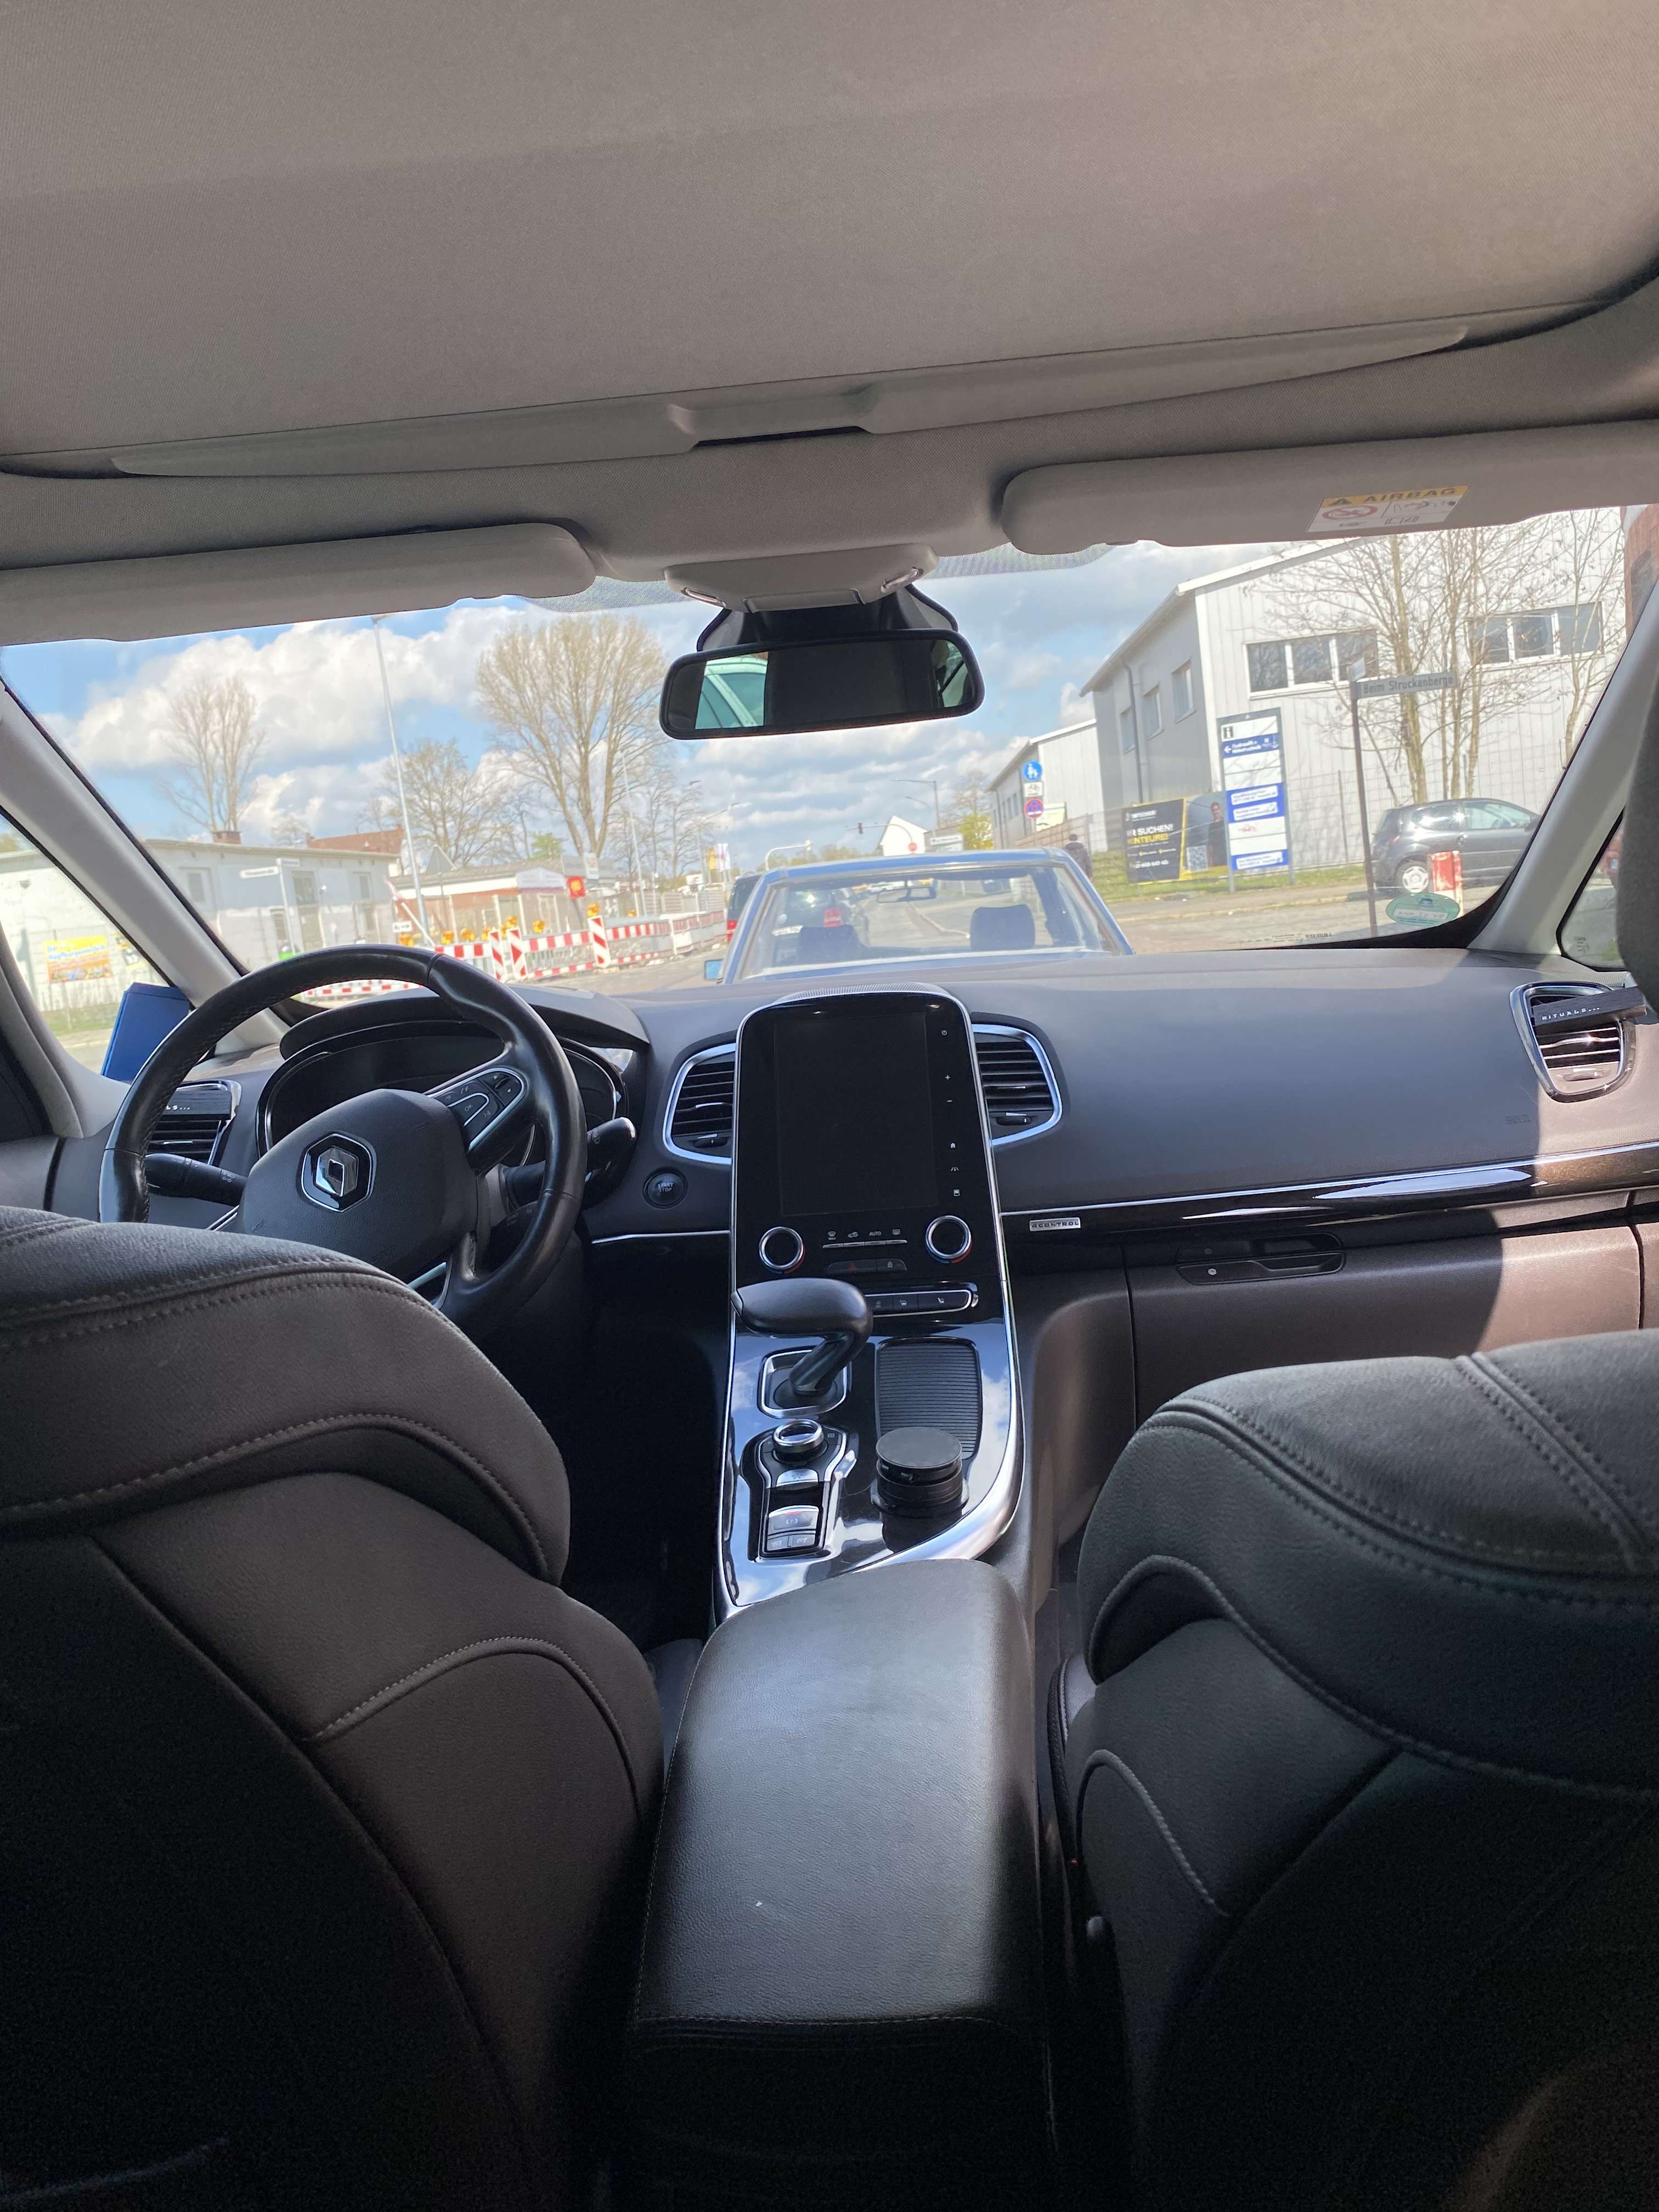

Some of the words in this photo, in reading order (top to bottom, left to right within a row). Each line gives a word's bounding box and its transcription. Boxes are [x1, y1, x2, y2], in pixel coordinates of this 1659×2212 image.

[1363, 488, 1457, 503] AIRBAG
[1363, 684, 1385, 694] Beim
[1389, 676, 1453, 691] Struckenberge
[1137, 823, 1173, 836] SUCHEN!
